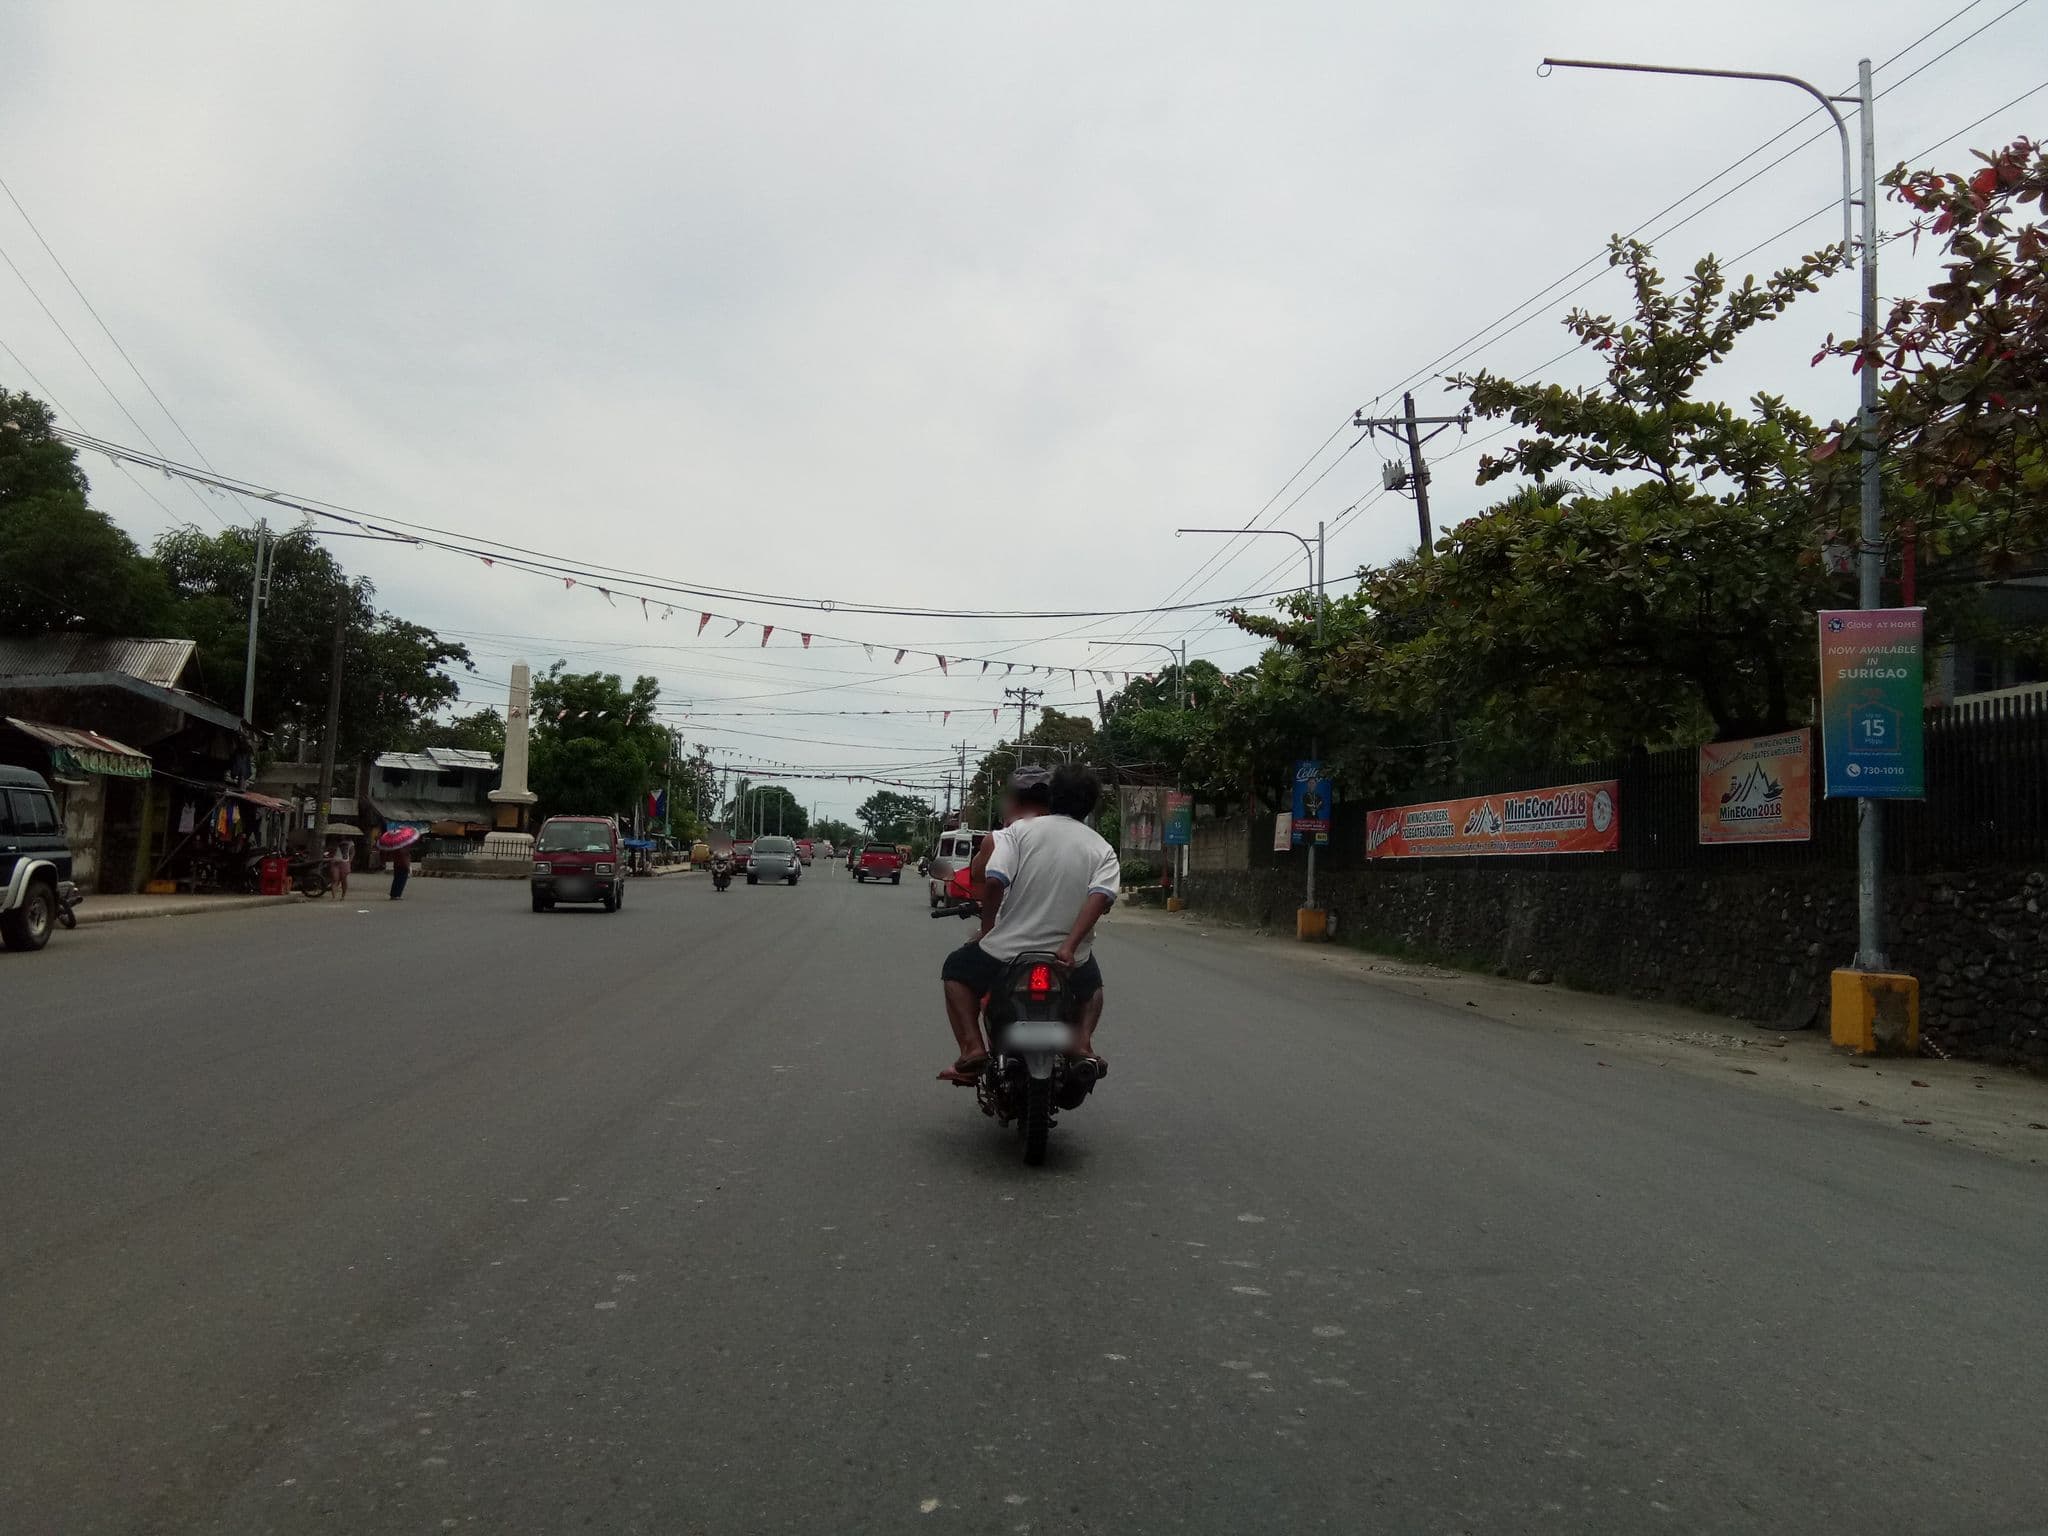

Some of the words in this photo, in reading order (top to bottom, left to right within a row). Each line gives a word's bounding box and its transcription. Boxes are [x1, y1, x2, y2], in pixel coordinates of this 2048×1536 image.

[1847, 621, 1873, 629] Globe
[1828, 646, 1856, 655] NOW
[1859, 645, 1918, 655] AVAILABLE
[1866, 657, 1879, 665] IN
[1838, 668, 1908, 679] SURIGAO
[1861, 719, 1885, 737] 15
[1863, 767, 1905, 775] 730-1010
[1504, 790, 1587, 820] MinECon2018
[1720, 803, 1782, 819] MinECon2018
